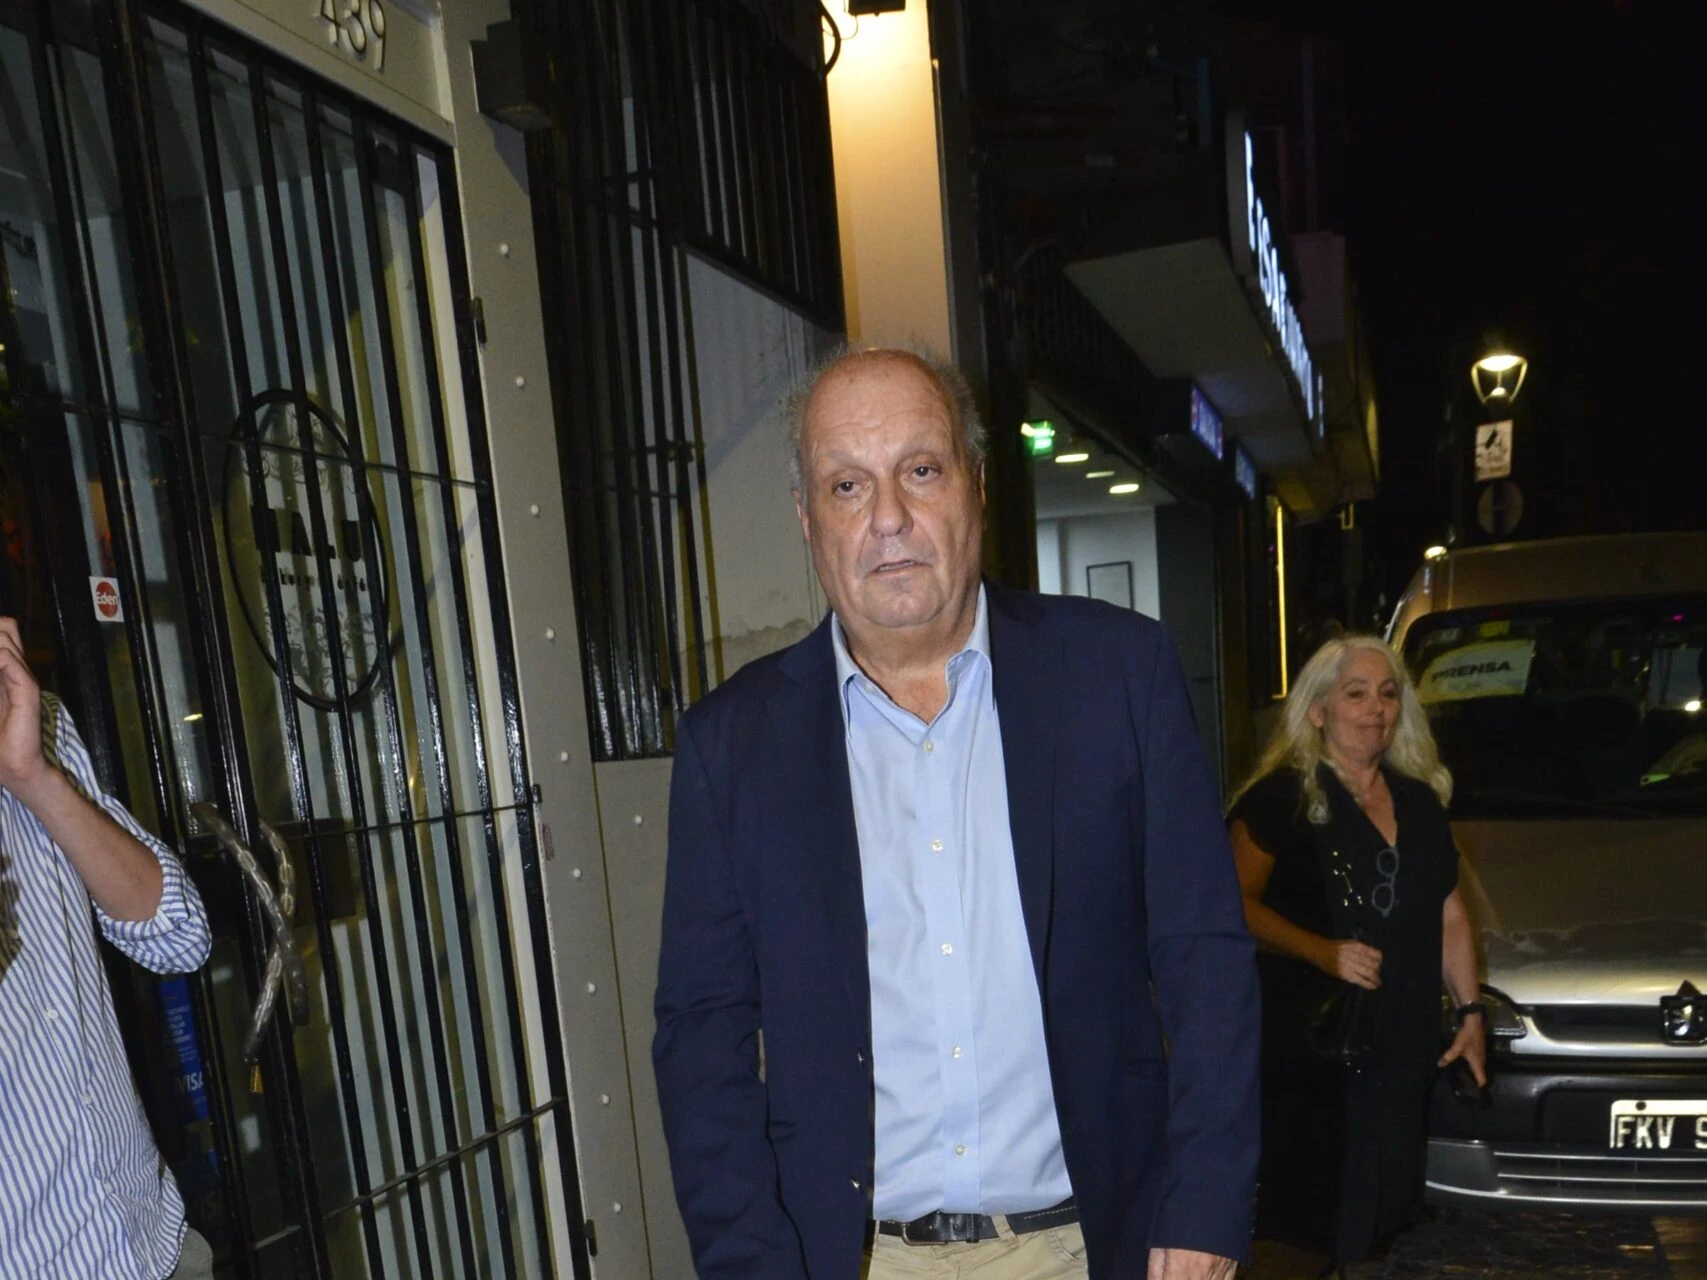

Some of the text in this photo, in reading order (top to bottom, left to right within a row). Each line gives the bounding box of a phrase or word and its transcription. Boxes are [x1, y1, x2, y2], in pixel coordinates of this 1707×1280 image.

[316, 0, 387, 69] 439
[97, 591, 119, 606] Eden
[1431, 660, 1512, 682] PRENSA
[1617, 1115, 1676, 1149] FKV
